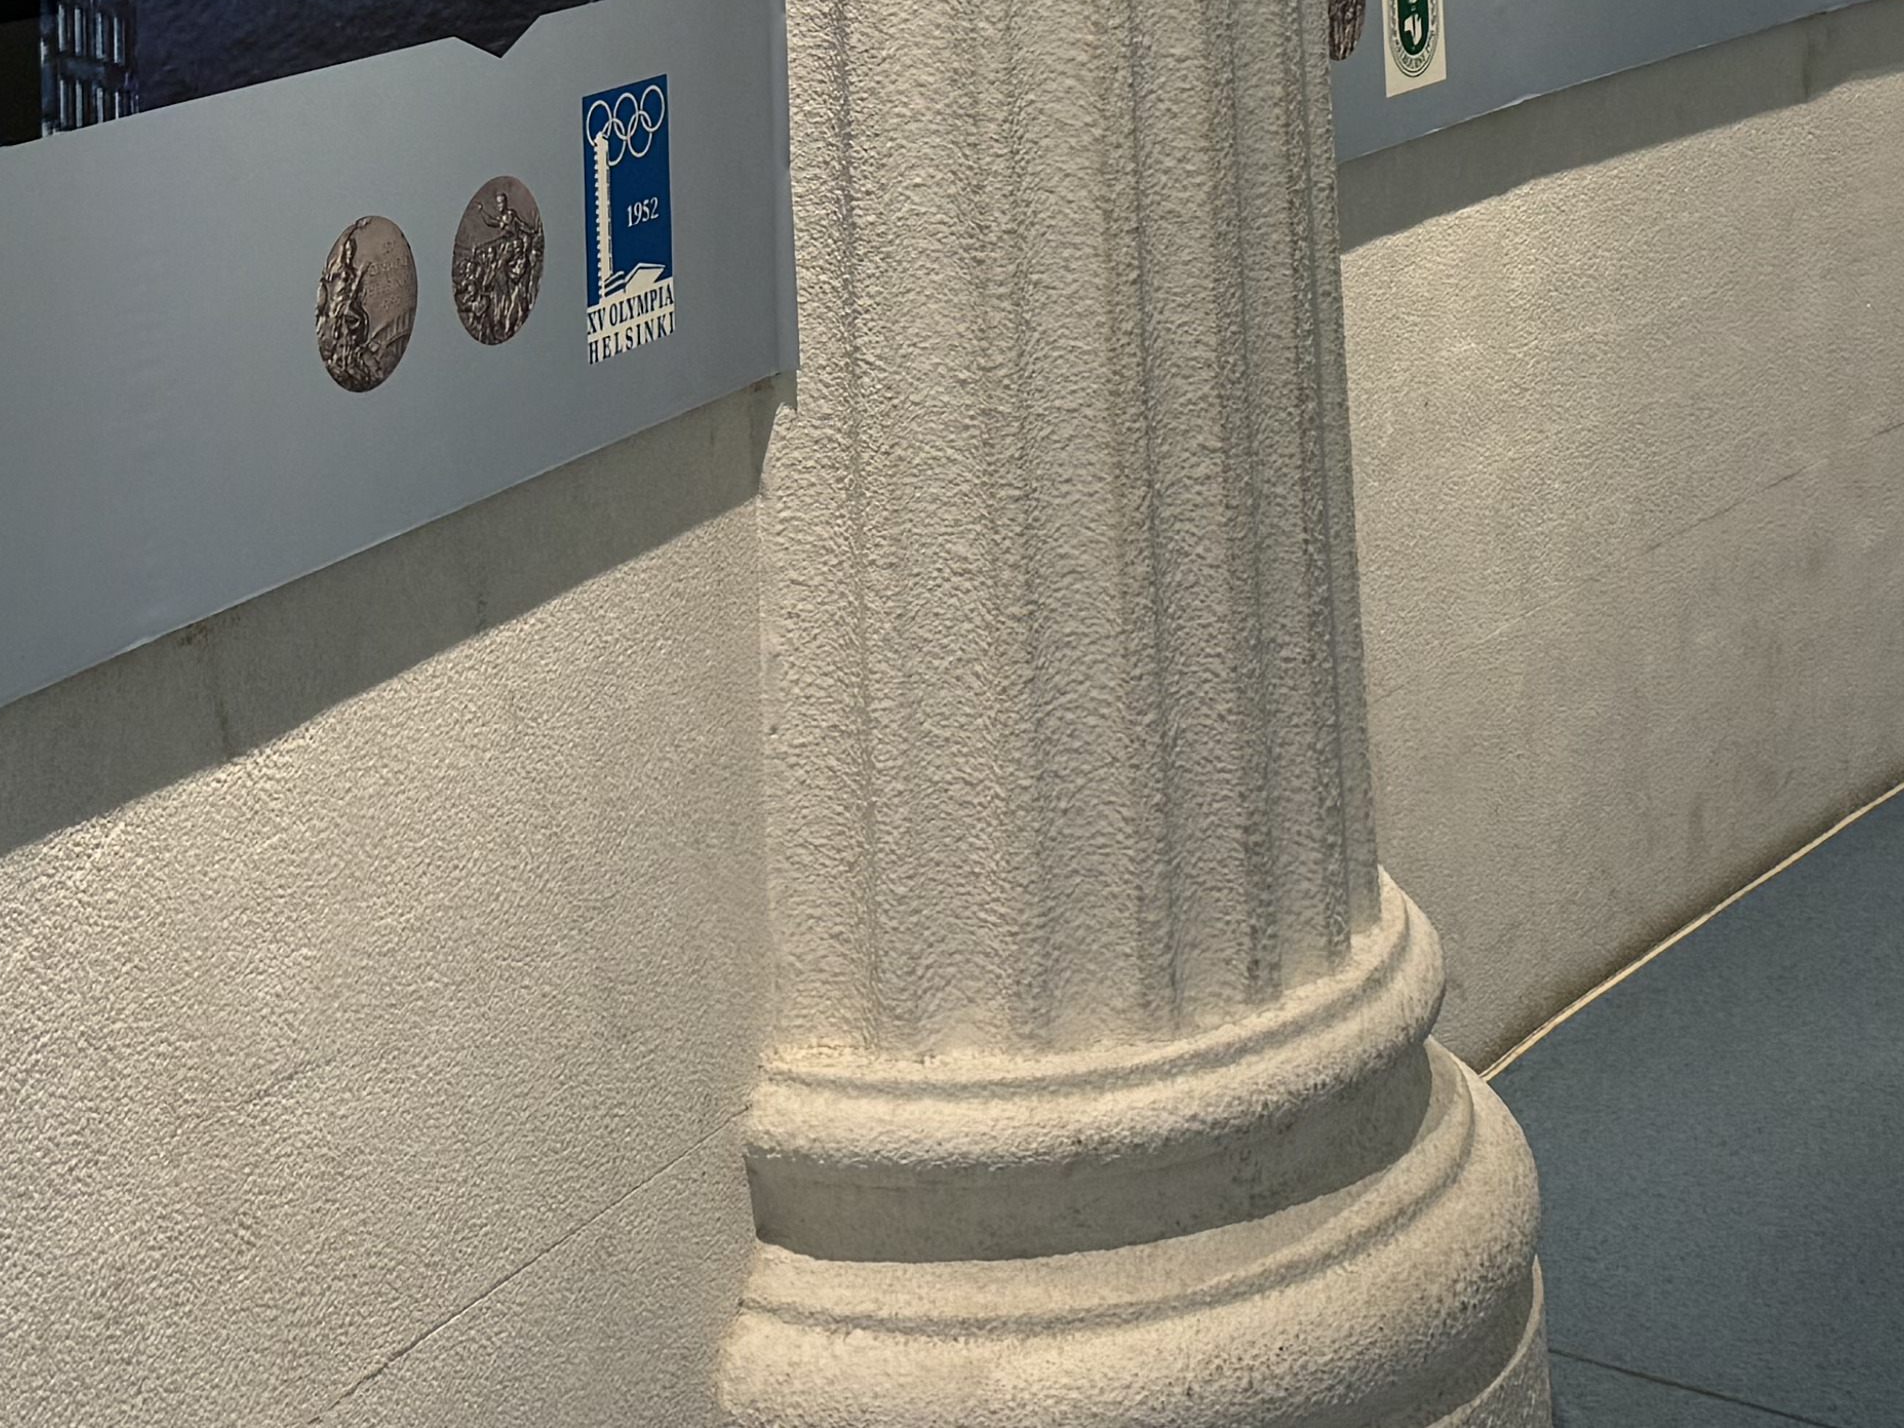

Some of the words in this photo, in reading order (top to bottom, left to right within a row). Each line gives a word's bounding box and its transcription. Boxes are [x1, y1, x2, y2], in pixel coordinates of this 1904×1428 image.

[626, 196, 659, 228] 1952
[587, 305, 606, 335] XV
[608, 284, 674, 327] OLYMPIA
[588, 312, 675, 365] HELSINKI
